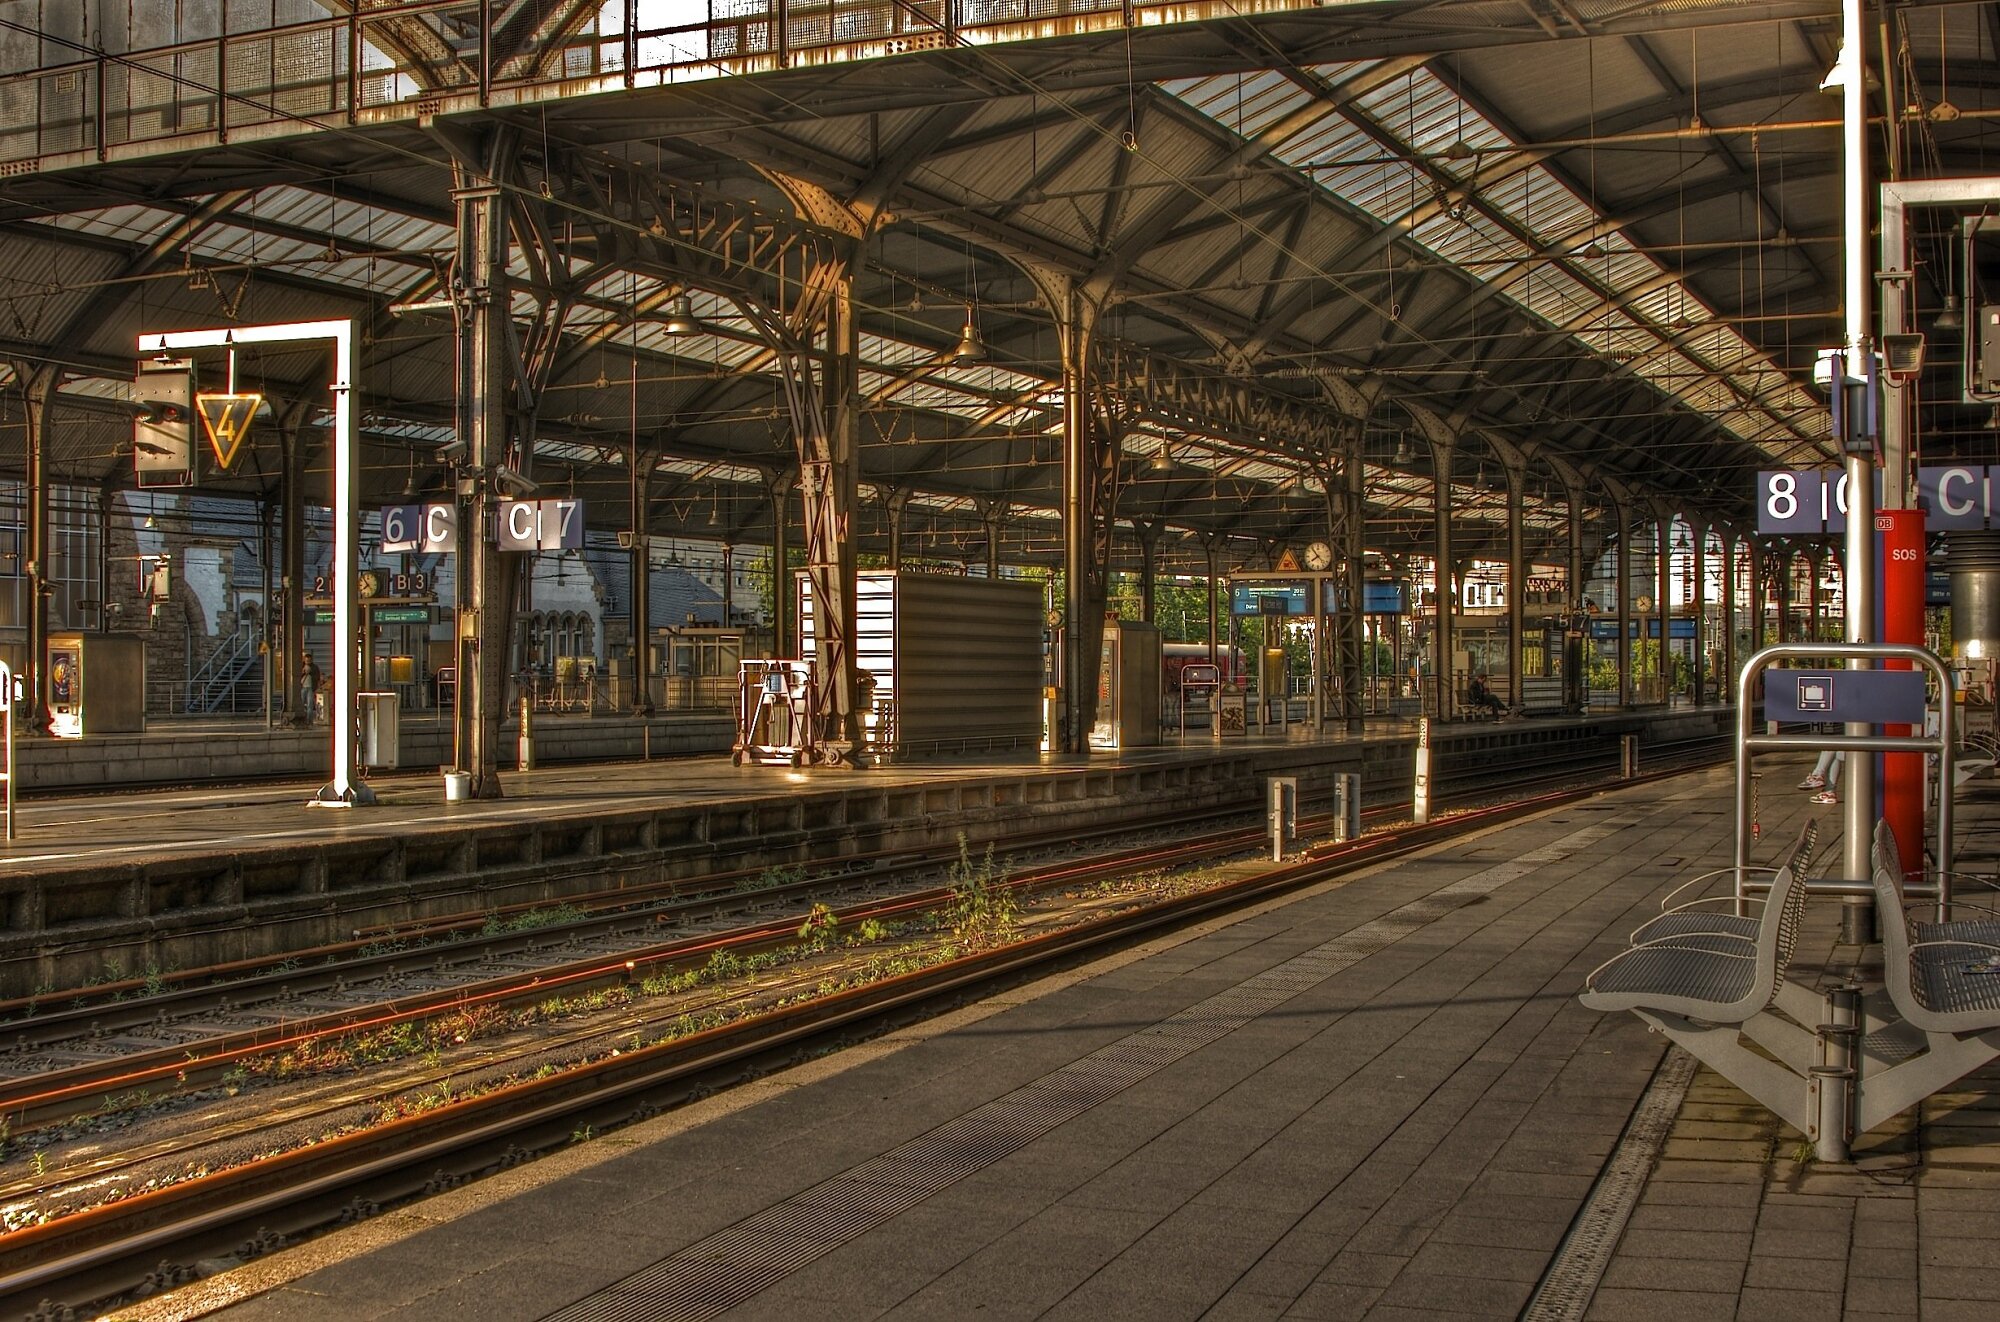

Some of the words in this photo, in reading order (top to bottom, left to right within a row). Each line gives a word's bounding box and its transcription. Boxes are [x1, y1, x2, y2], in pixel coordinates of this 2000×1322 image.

[216, 404, 236, 442] 4
[1766, 473, 1798, 519] 8
[1938, 468, 1975, 516] C
[386, 507, 404, 542] 6
[427, 506, 449, 543] C
[508, 503, 533, 540] C
[556, 502, 577, 538] 7
[1877, 519, 1892, 528] DB
[1892, 549, 1917, 561] SOS
[316, 576, 325, 592] 2
[397, 574, 407, 590] B
[415, 574, 425, 590] 3
[1234, 588, 1240, 597] 6
